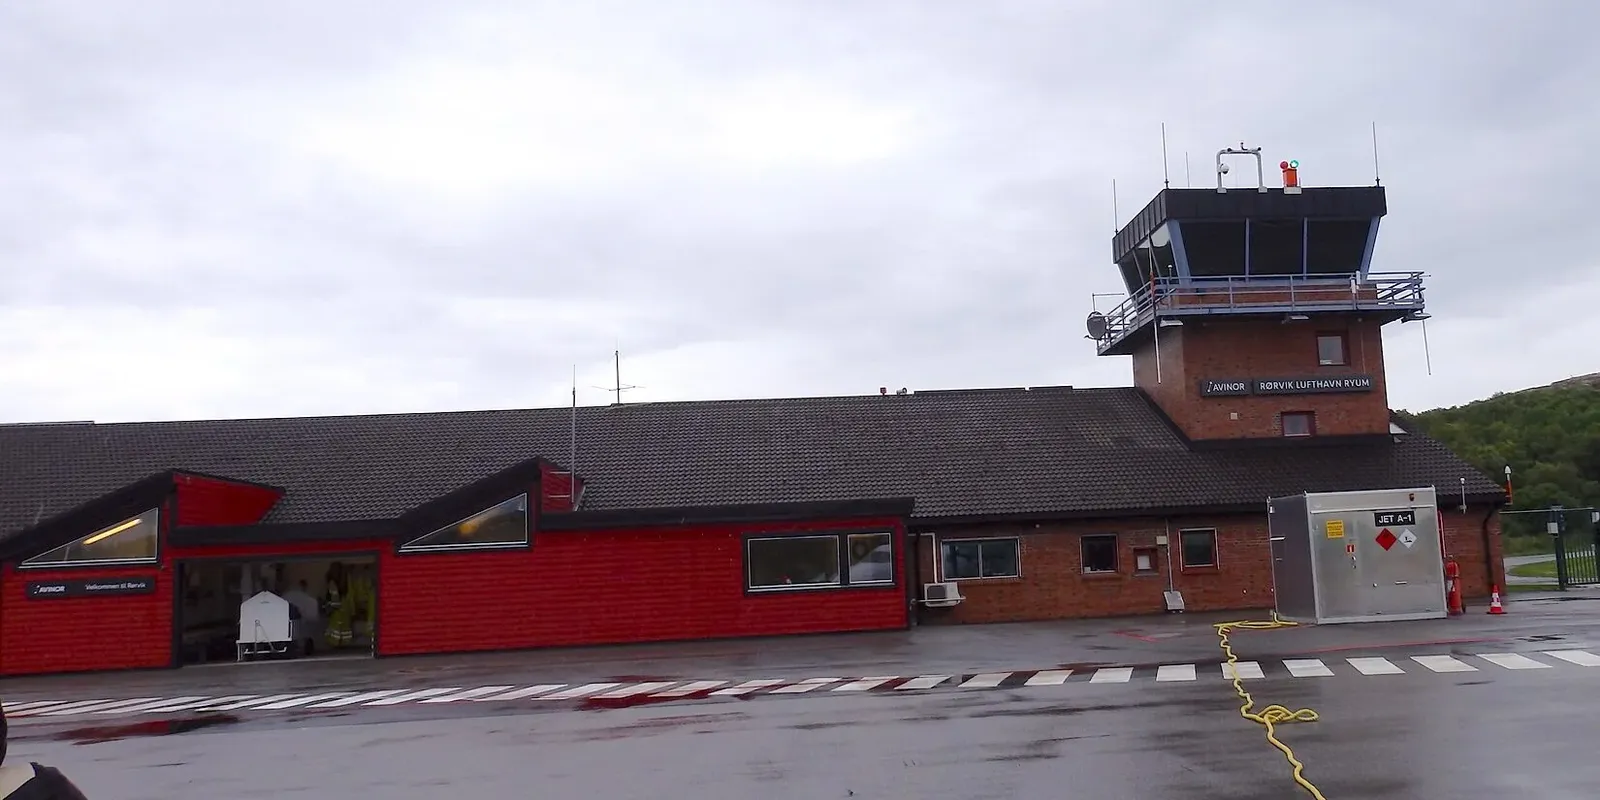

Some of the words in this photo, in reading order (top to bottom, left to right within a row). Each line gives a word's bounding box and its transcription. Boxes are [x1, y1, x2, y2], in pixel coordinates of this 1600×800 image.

[1213, 382, 1245, 391] AVINOR
[1260, 381, 1294, 390] RØRVIK
[1296, 380, 1342, 389] LUFTHAVN
[1344, 379, 1370, 387] RYUM
[1379, 515, 1394, 523] JET
[1397, 514, 1412, 522] A-1
